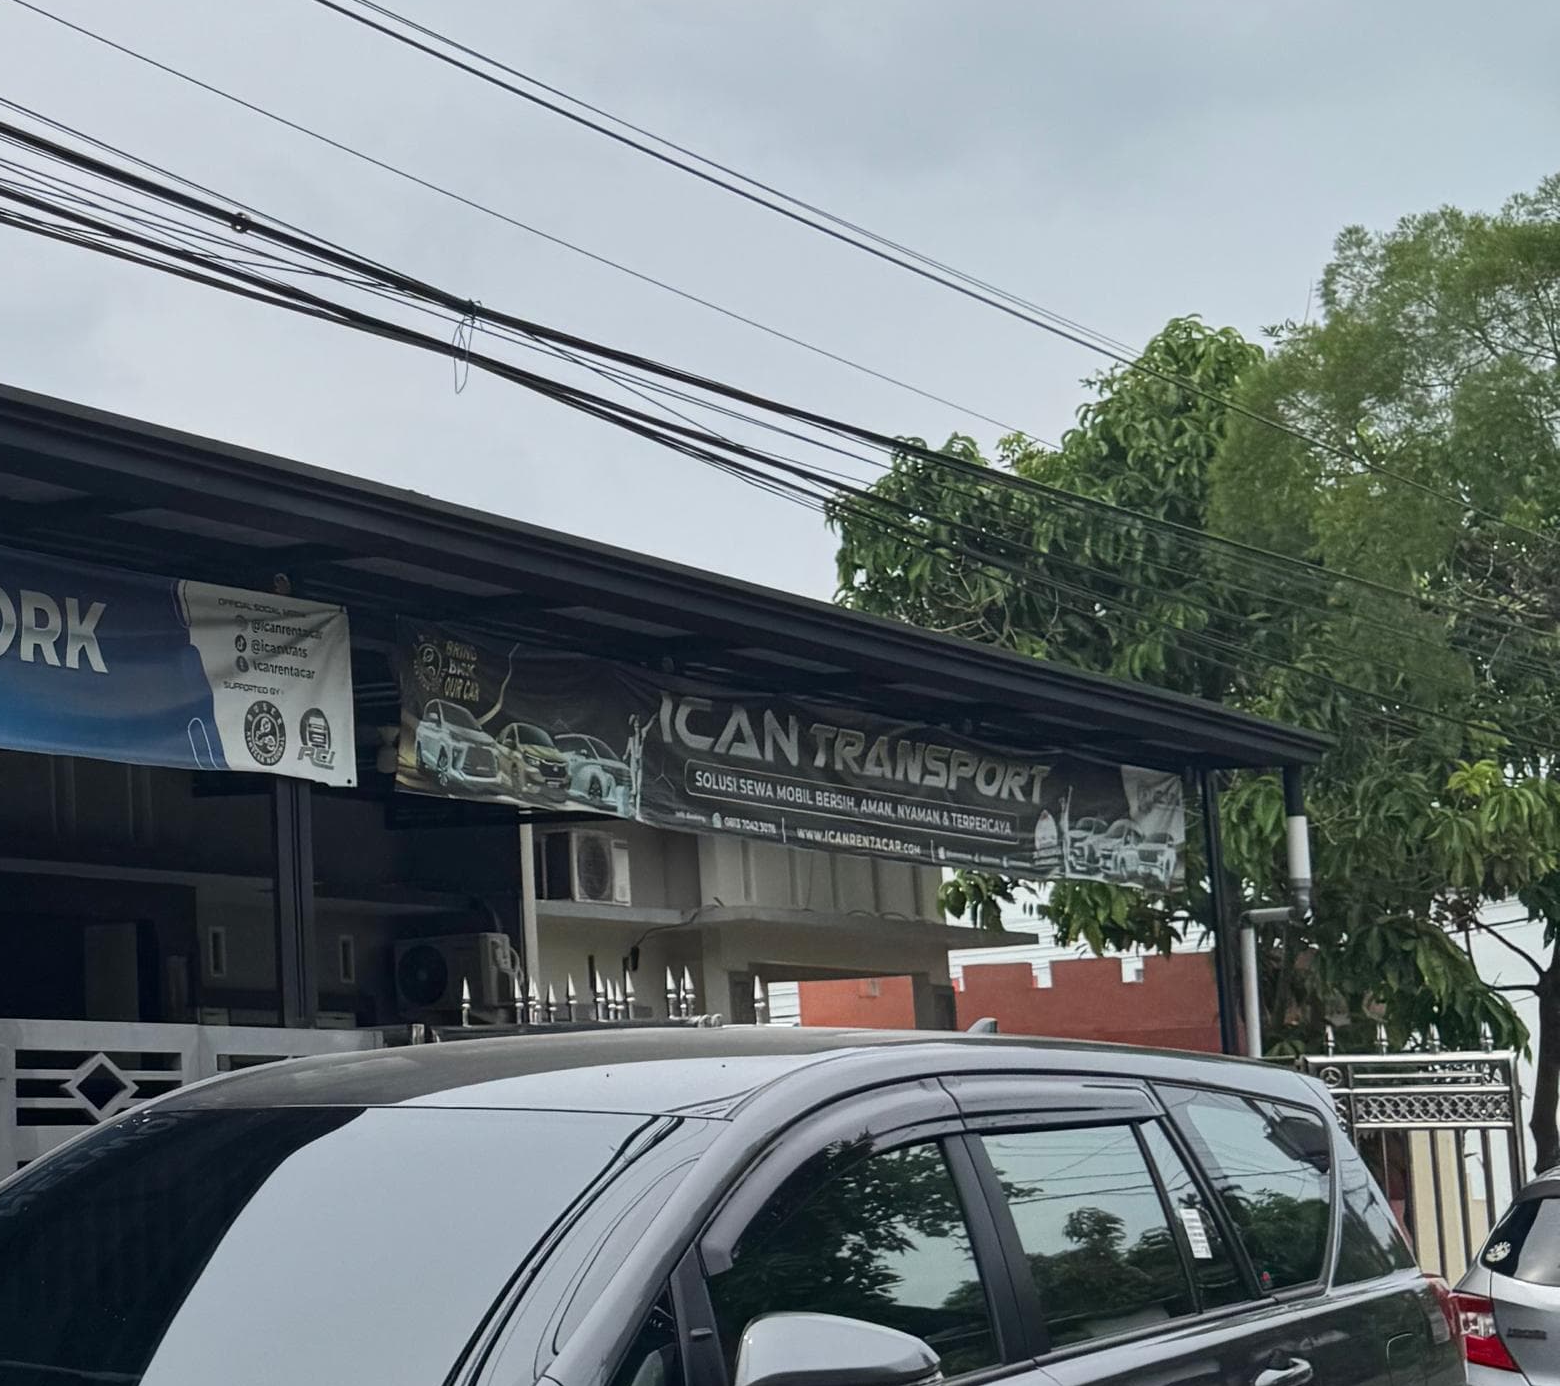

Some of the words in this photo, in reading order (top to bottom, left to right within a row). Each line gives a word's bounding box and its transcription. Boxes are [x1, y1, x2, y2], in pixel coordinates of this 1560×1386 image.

[659, 689, 800, 767] ICAN
[809, 722, 1051, 805] TRANSPORT
[695, 770, 739, 793] SOLUSI
[739, 778, 775, 799] SEWA
[776, 783, 814, 805] MOBIL
[896, 804, 941, 826] NYAMAN
[943, 811, 950, 827] &
[951, 812, 1013, 836] TERPERCAYA
